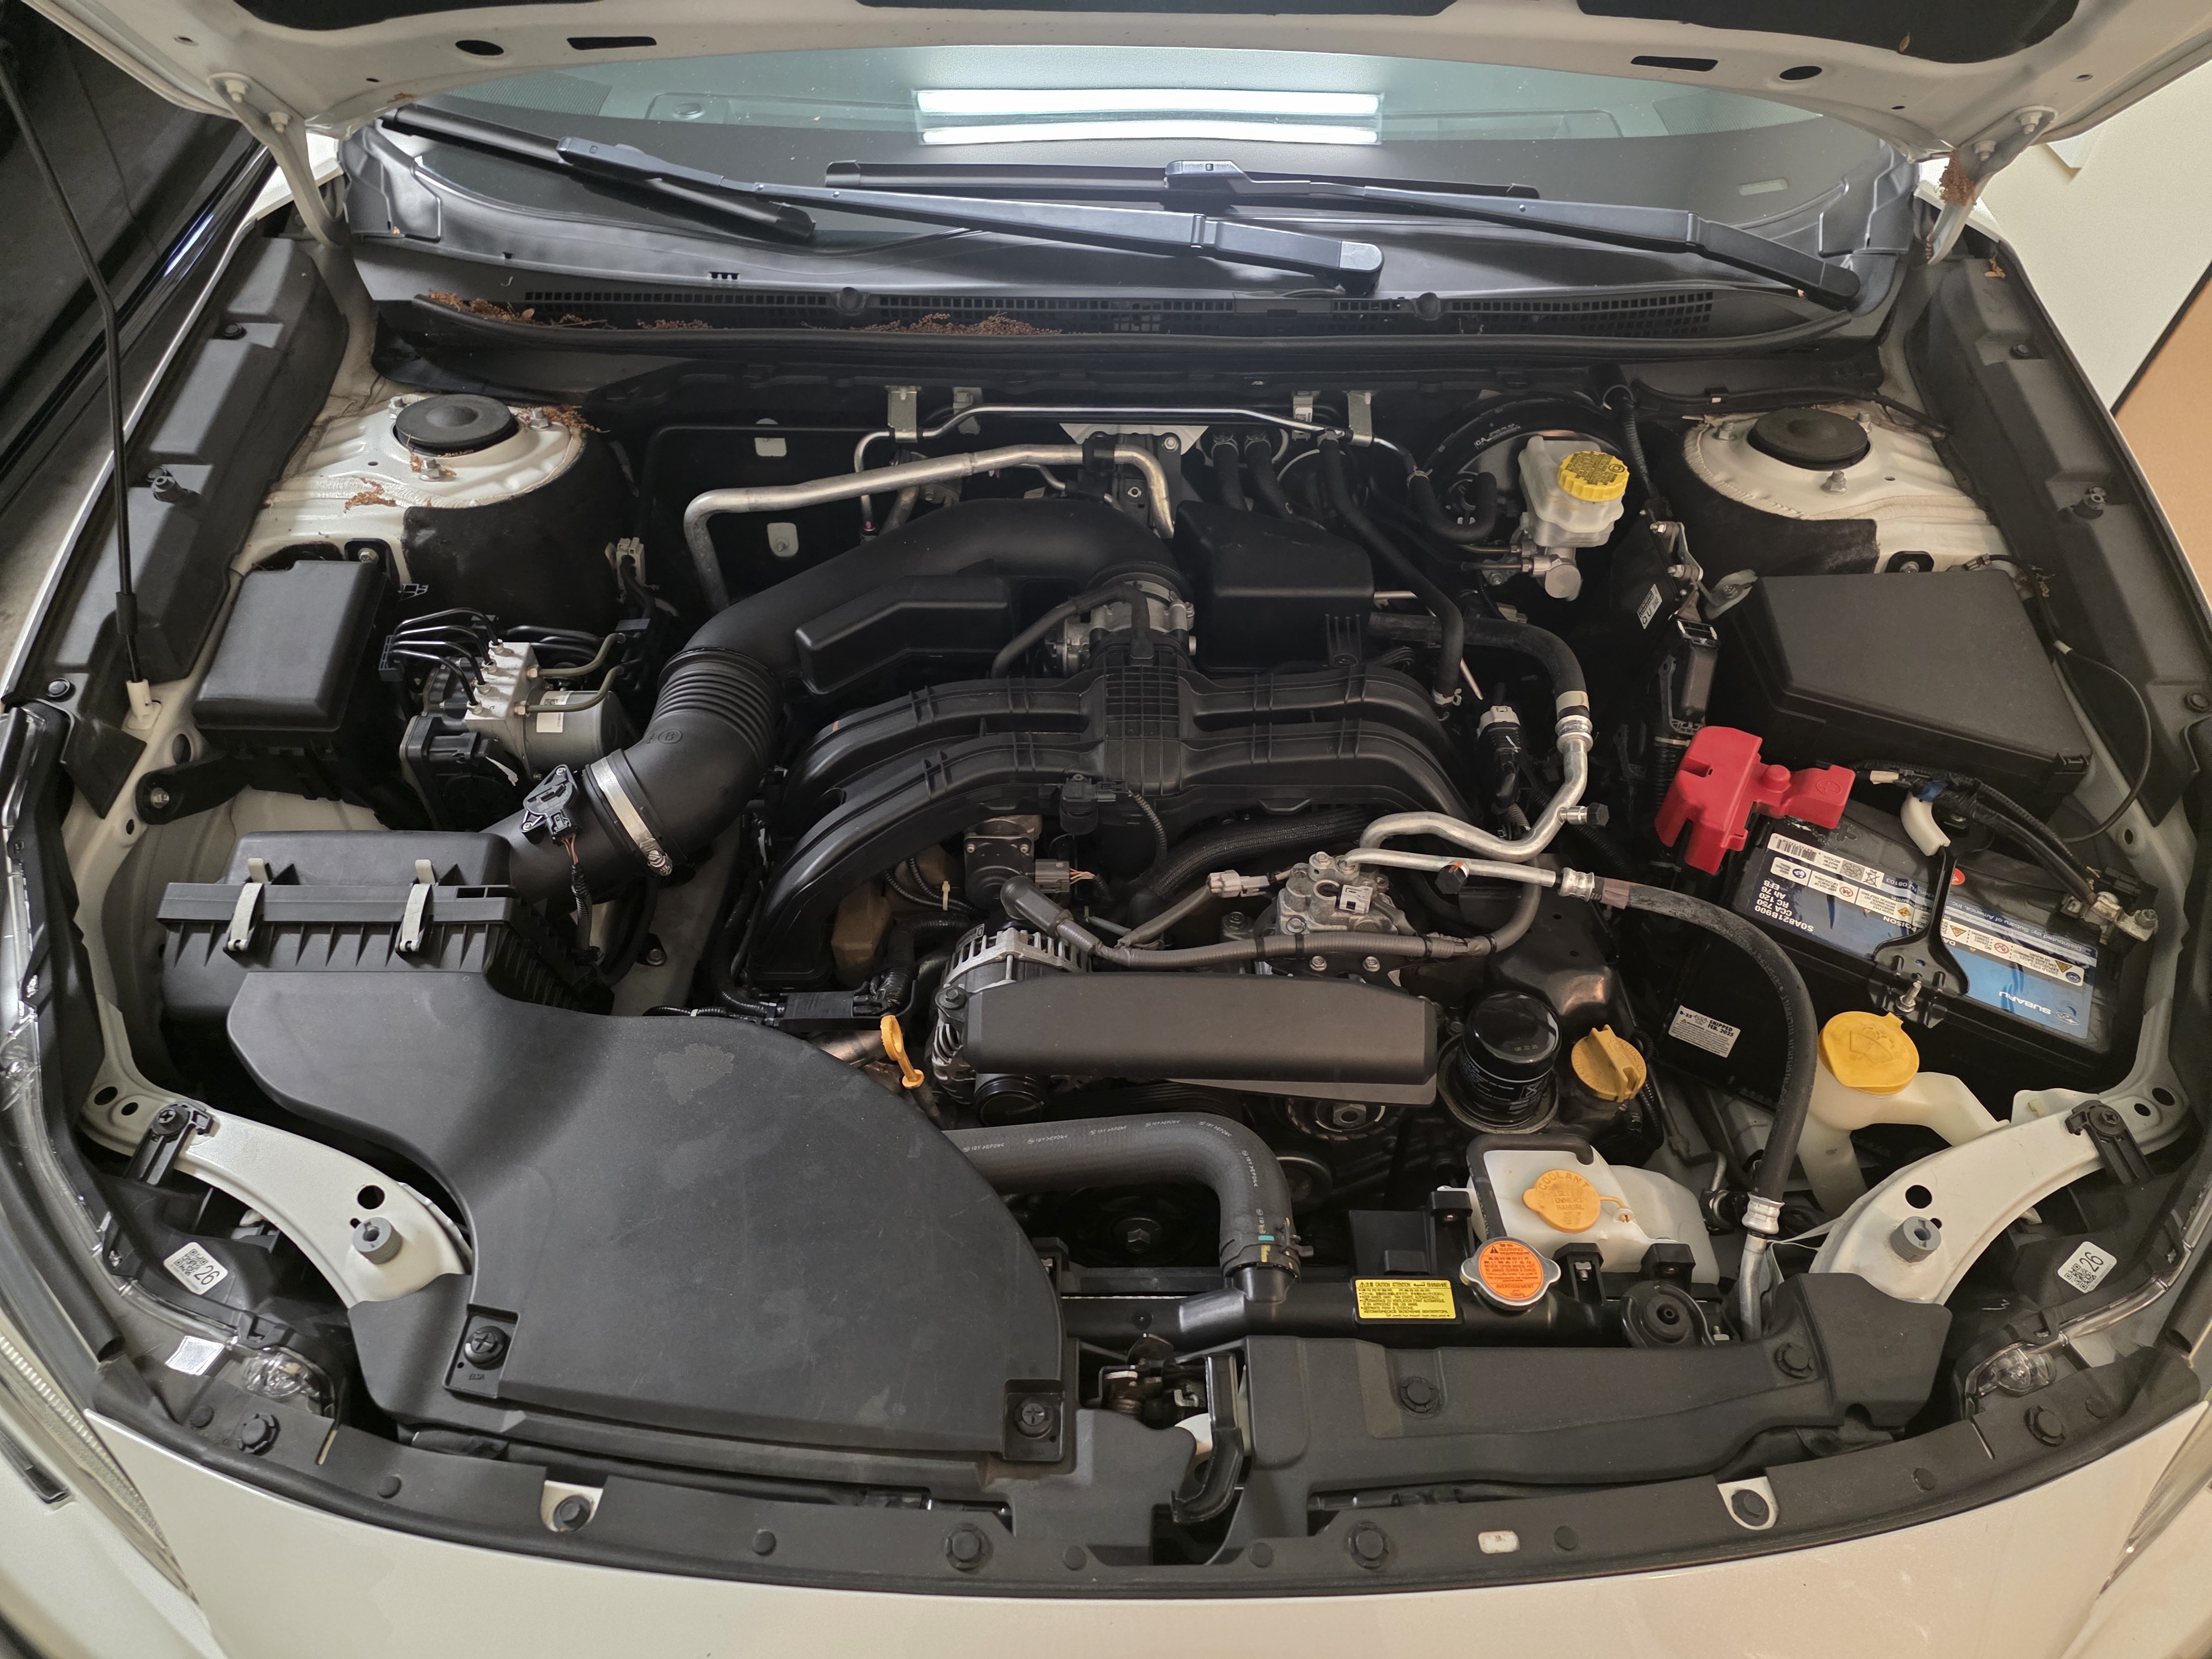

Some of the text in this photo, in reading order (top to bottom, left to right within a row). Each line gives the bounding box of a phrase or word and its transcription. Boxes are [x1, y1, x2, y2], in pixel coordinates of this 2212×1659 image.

[1762, 879, 1780, 890] EFB
[1885, 876, 1907, 888] 08103
[1758, 892, 1789, 908] RC 120
[1760, 885, 1786, 900] Ah 76
[1756, 898, 1792, 916] CCA 750
[2003, 919, 2029, 932] Subaru
[2030, 928, 2042, 937] by:
[2042, 933, 2082, 952] Distributed
[2018, 954, 2059, 972] EXPLOSIVE GASES
[1997, 990, 2052, 1014] SUBARU
[1709, 1019, 1733, 1032] SHIPPED
[1719, 1028, 1734, 1037] 2025
[1537, 1172, 1590, 1190] COOLANT
[2078, 1251, 2104, 1274] 26
[194, 1264, 218, 1286] 26
